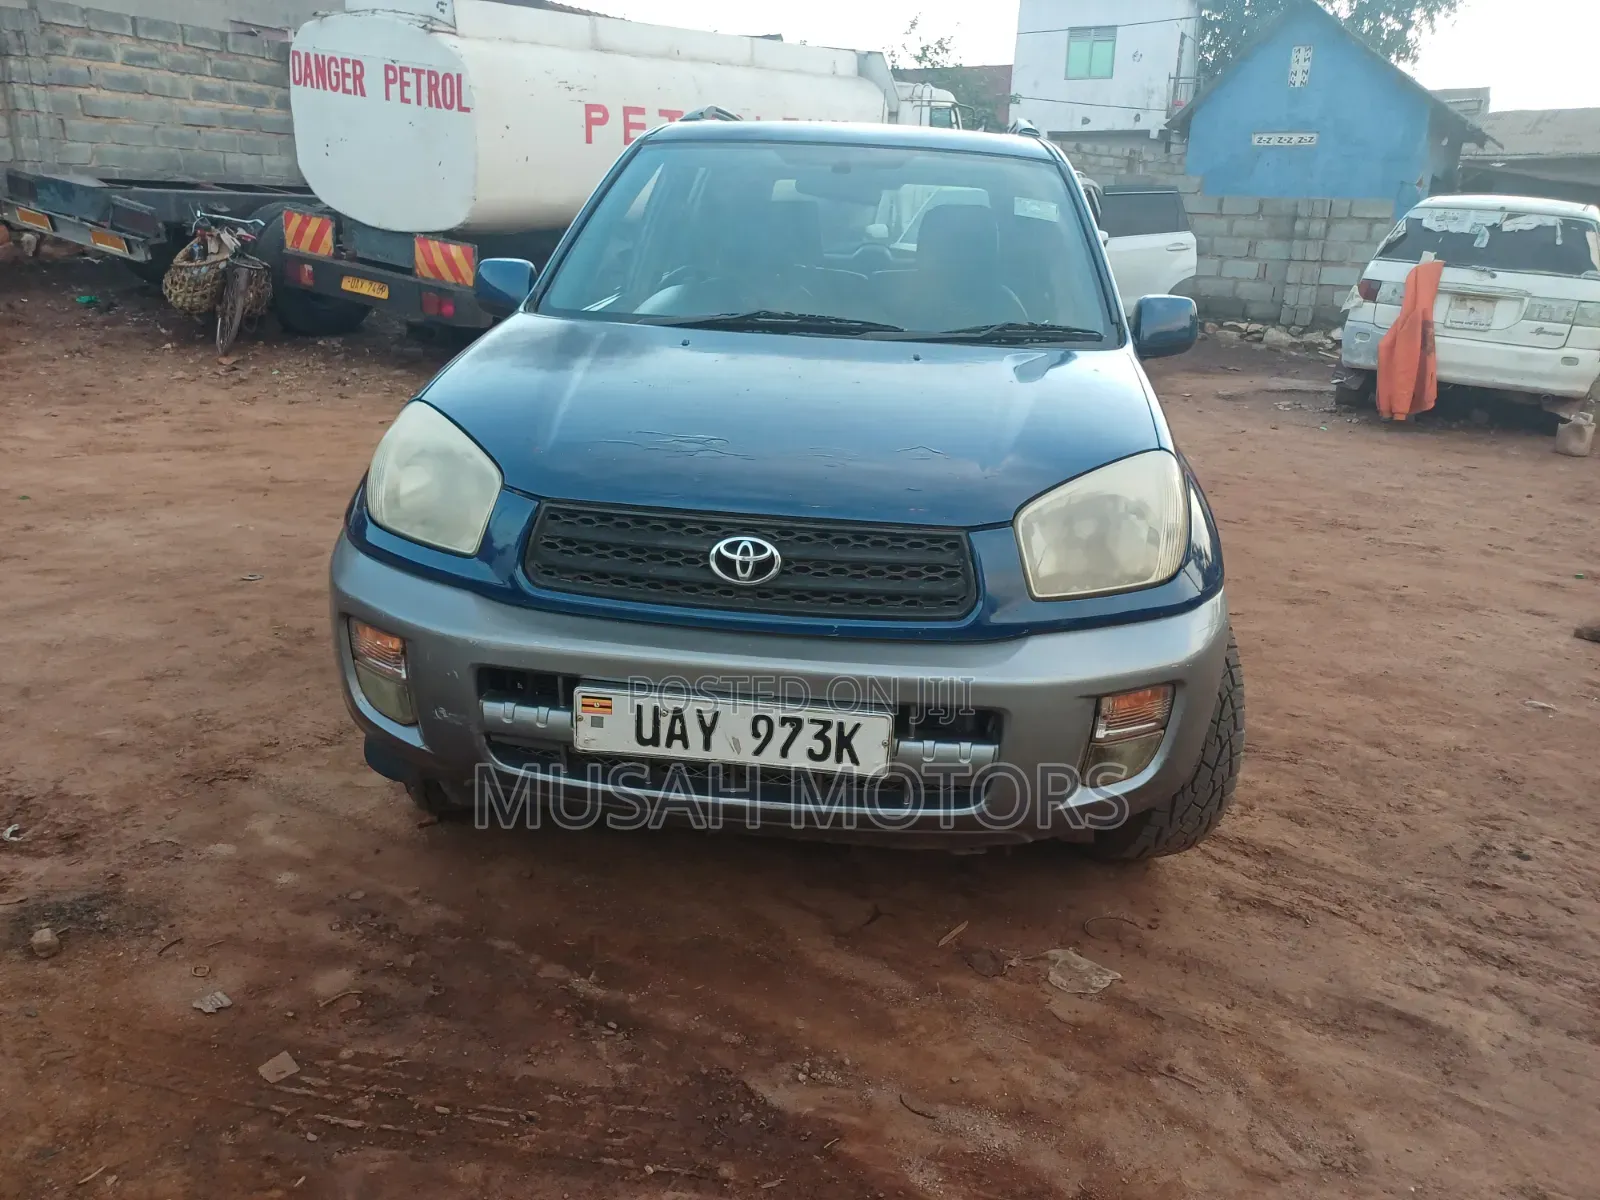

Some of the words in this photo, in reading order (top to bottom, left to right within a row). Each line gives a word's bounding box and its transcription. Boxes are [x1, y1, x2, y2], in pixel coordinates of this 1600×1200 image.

[291, 50, 367, 98] DANGER
[384, 63, 471, 113] PETROL
[635, 703, 721, 752] UAY
[751, 713, 863, 767] 973K
